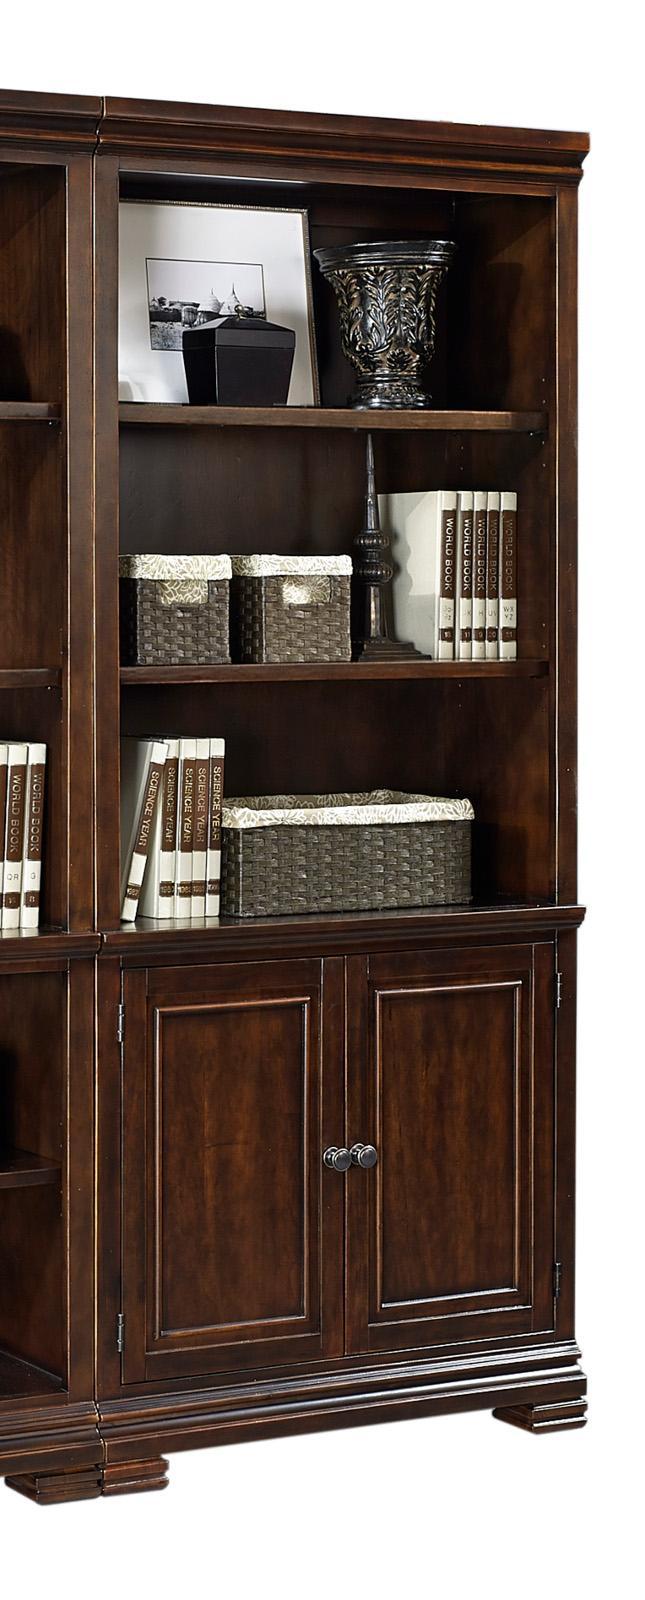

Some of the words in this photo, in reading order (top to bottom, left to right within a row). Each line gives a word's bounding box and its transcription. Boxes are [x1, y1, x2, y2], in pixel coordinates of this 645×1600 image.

[445, 518, 454, 555] WORLD
[463, 518, 472, 555] WORLD
[477, 519, 486, 555] WORLD
[489, 519, 498, 555] WORLD
[505, 519, 513, 555] WORLD
[444, 559, 453, 591] BOOK
[463, 560, 472, 591] BOOK
[477, 560, 486, 591] BOOK
[489, 560, 497, 591] BOOK
[505, 560, 513, 591] BOOK
[12, 774, 22, 816] WORLD
[32, 772, 43, 814] WORLD
[144, 771, 160, 817] SCIENCE
[166, 767, 176, 812] SCIENCE
[184, 768, 193, 813] SCIENCE
[197, 767, 206, 812] SCIENCE
[212, 766, 222, 811] SCIENCE
[10, 819, 20, 853] BOOK
[30, 817, 40, 852] BOOK
[138, 817, 151, 847] YEAR
[165, 814, 174, 843] YEAR
[183, 815, 192, 843] YEAR
[196, 815, 206, 843] YEAR
[211, 812, 221, 841] YEAR
